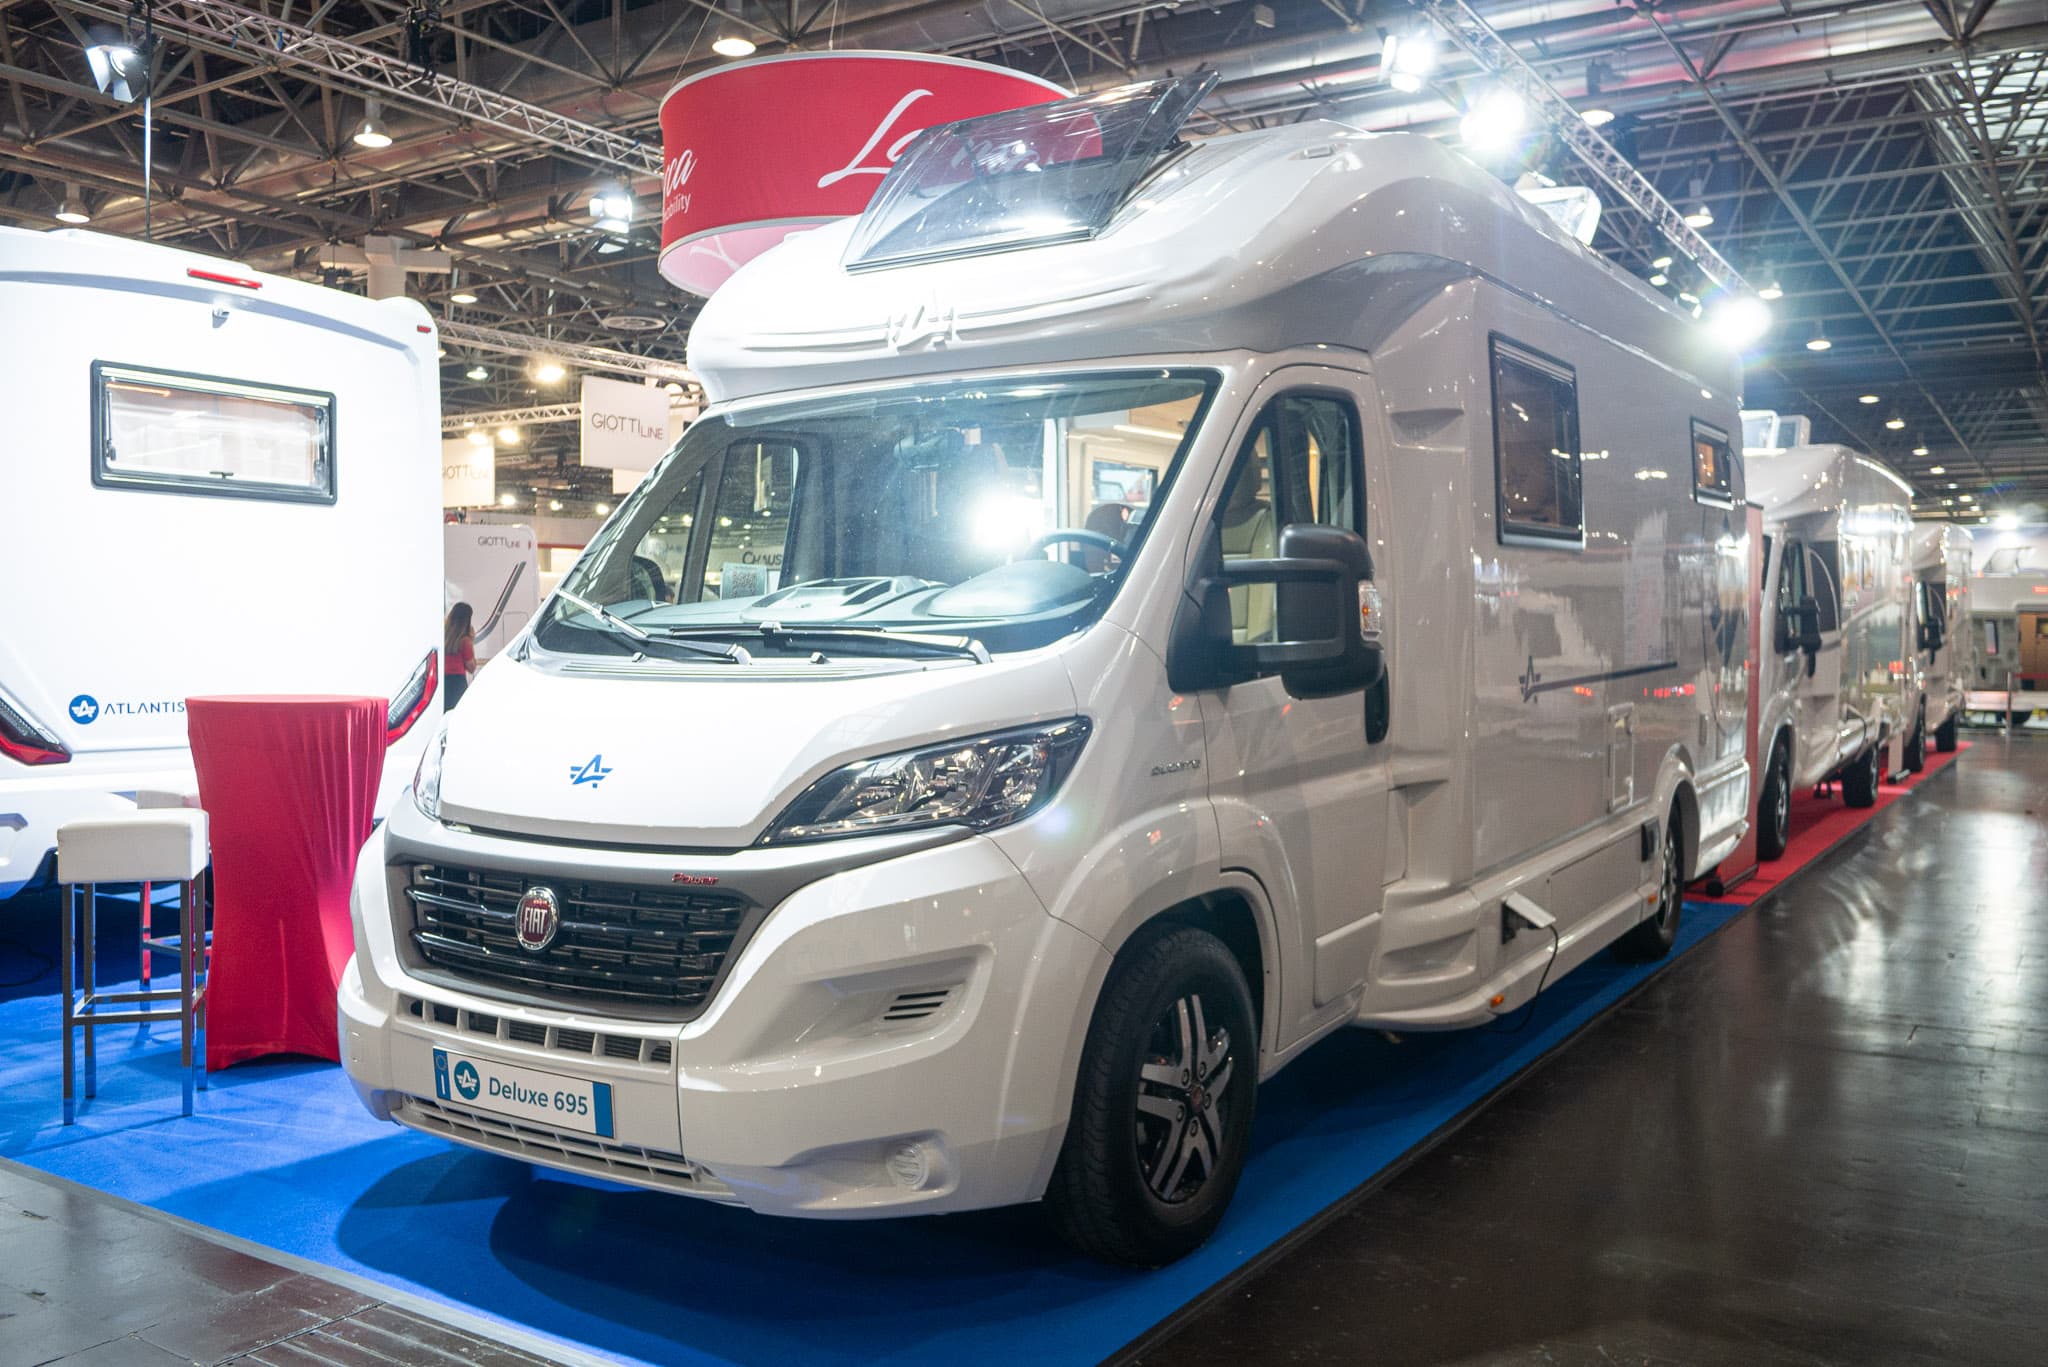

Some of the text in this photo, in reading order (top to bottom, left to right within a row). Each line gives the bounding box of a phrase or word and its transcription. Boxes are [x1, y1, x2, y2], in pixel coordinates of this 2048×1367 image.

[104, 702, 185, 715] ATLANTIS
[523, 906, 548, 934] FIAT
[488, 1076, 588, 1116] Deluxe 695
